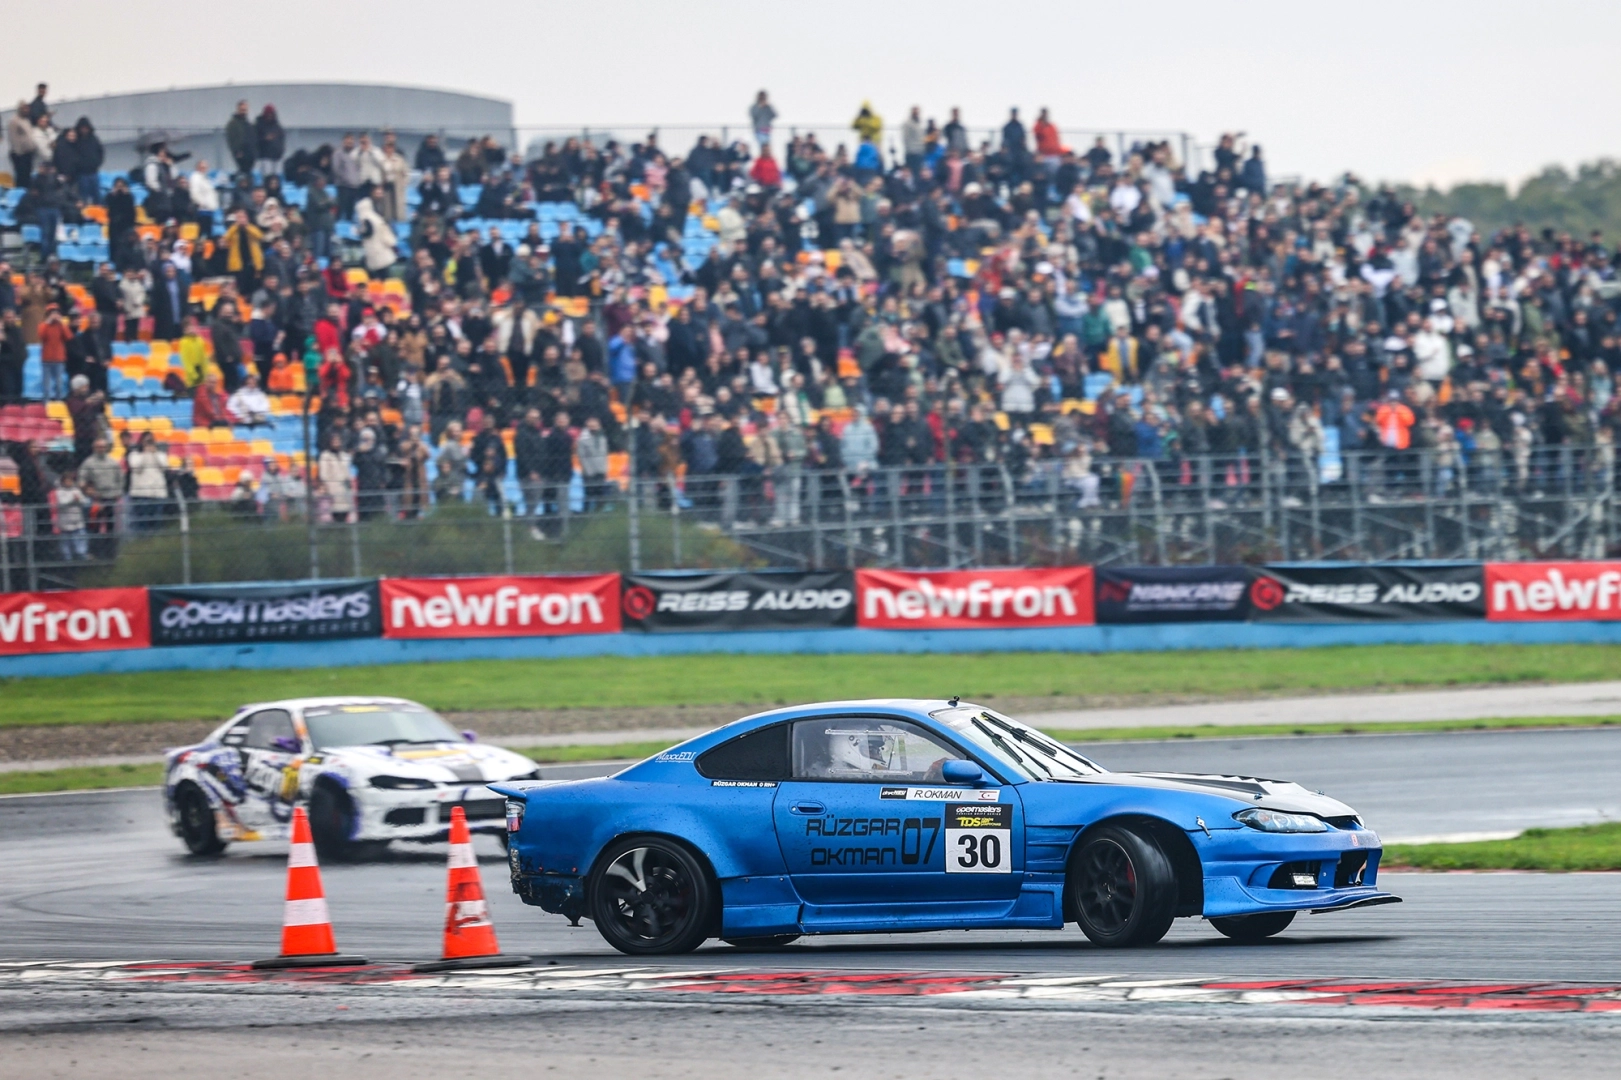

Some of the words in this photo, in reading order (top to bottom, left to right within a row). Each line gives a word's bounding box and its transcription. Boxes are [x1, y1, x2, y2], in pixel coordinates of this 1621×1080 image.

[657, 590, 750, 612] REISS
[753, 588, 852, 611] AUDIO
[864, 577, 1077, 619] newfron
[1284, 582, 1379, 603] REISS
[1381, 582, 1481, 603] AUDIO
[1493, 568, 1621, 611] newf
[391, 583, 604, 628] newfron
[246, 625, 298, 637] DRIFT
[308, 621, 371, 634] SERIES
[806, 815, 900, 837] RÜZGAR
[955, 816, 981, 827] TDS
[901, 817, 941, 865] 07
[957, 834, 1002, 868] 30
[811, 847, 896, 866] OKMAN
